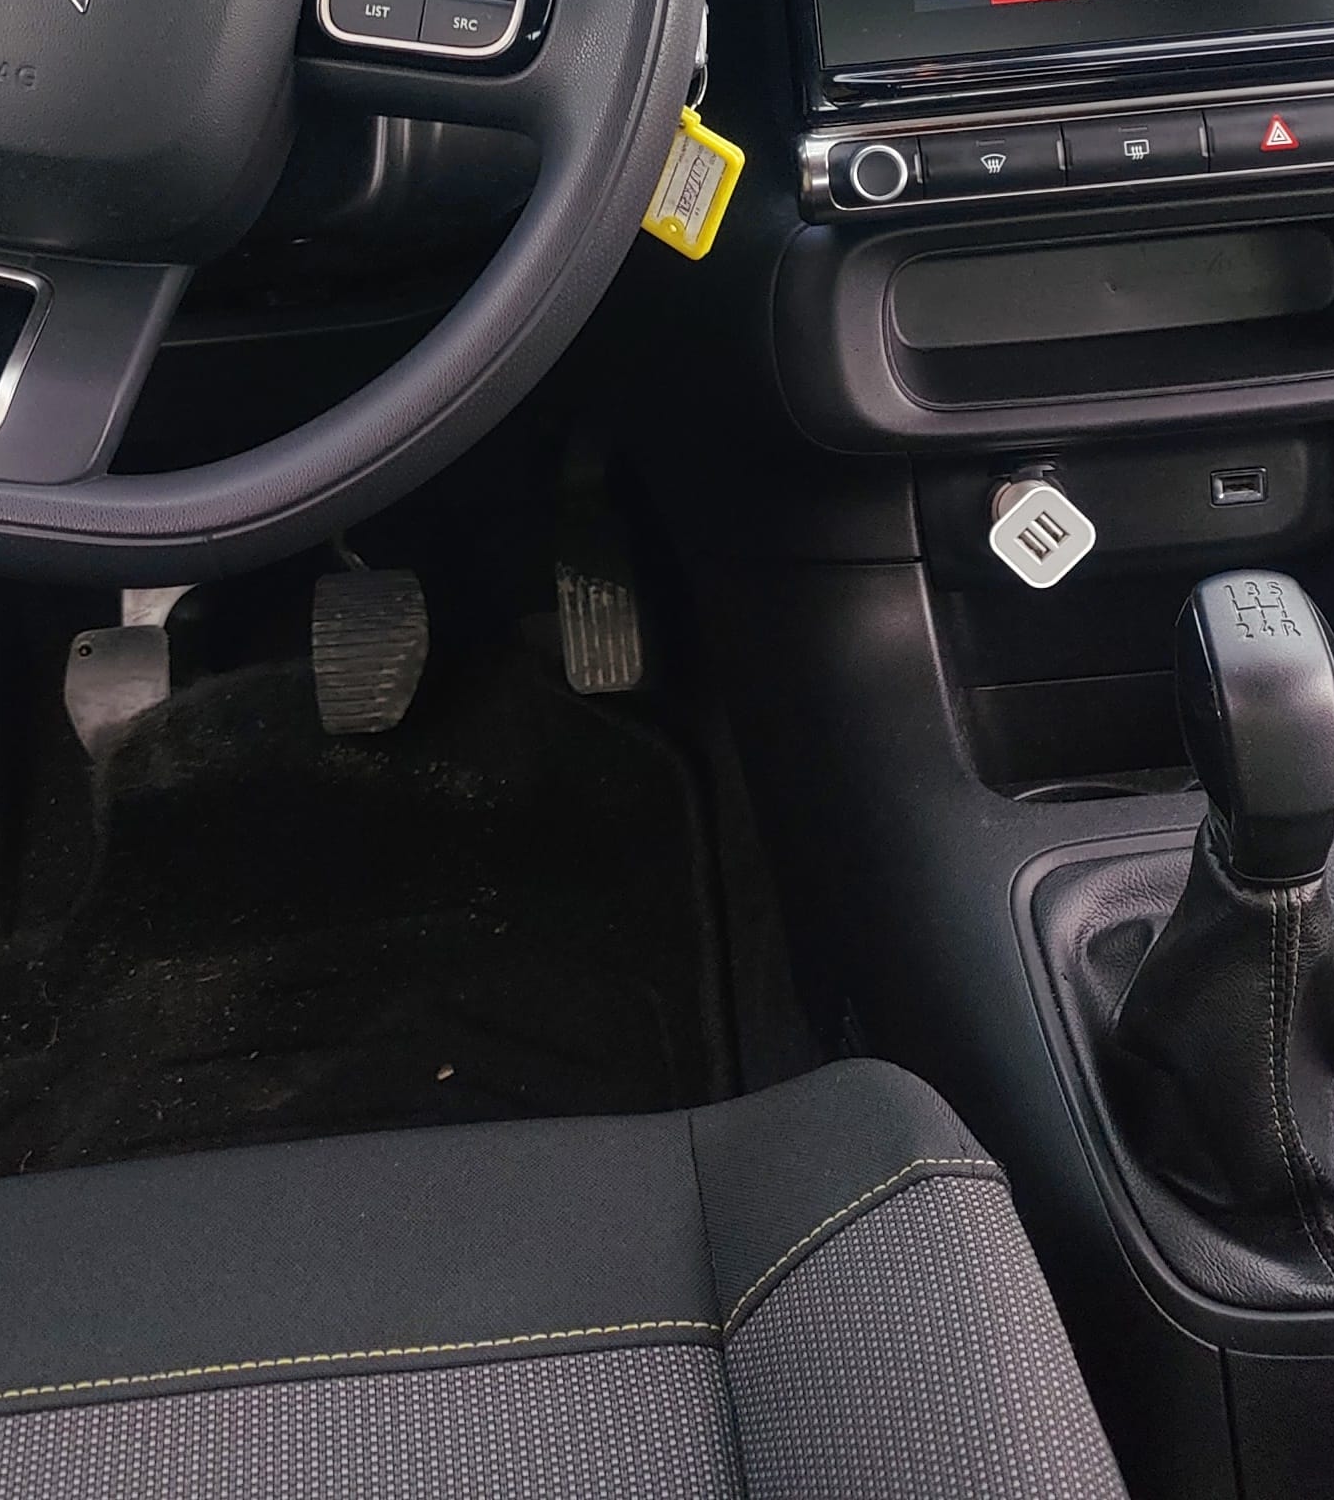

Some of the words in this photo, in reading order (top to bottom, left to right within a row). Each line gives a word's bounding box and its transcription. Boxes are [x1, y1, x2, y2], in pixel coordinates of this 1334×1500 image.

[365, 4, 390, 18] LIST
[453, 17, 478, 31] SRC
[1224, 584, 1235, 598] 1
[1245, 581, 1260, 595] 3
[1267, 581, 1283, 595] 5
[1236, 622, 1254, 638] 2
[1260, 619, 1275, 636] 4
[1281, 619, 1301, 636] R
